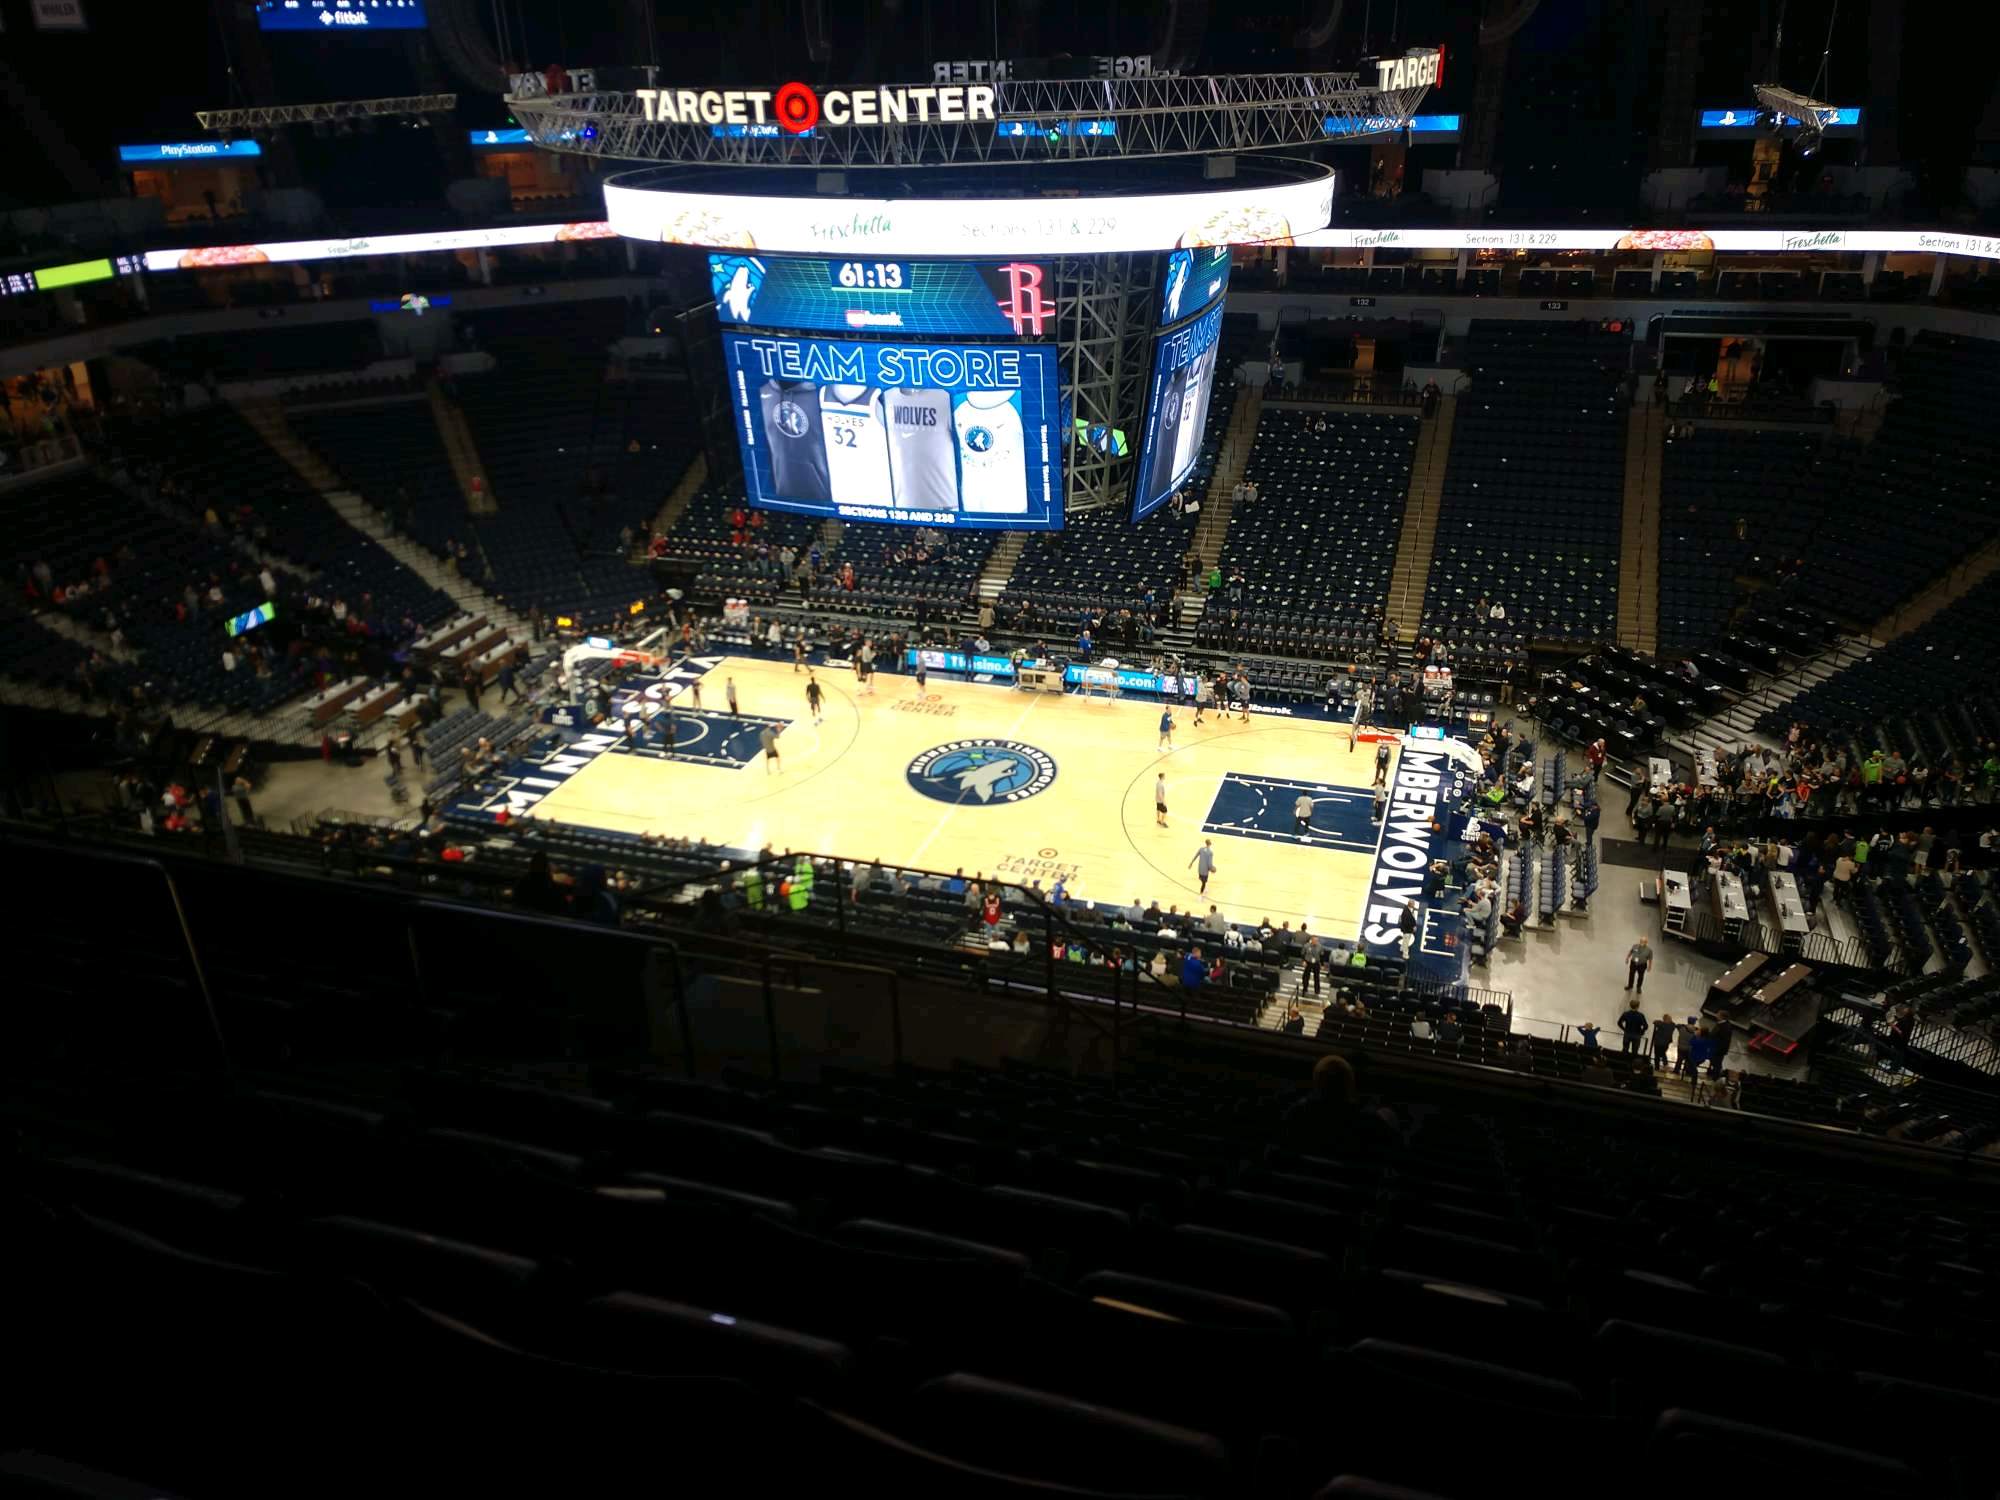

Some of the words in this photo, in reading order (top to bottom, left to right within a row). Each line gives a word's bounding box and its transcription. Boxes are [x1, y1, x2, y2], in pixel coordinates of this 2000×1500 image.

[334, 11, 368, 24] fitbit
[1376, 53, 1440, 92] TARGET
[636, 89, 770, 124] TARGET
[823, 86, 996, 124] CENTER
[161, 144, 217, 157] PlayStation
[1070, 219, 1081, 235] &
[1088, 217, 1117, 236] 229
[1466, 233, 1504, 244] Sections
[1508, 233, 1524, 244] 131
[1538, 234, 1557, 245] 229
[1918, 235, 1960, 249] Sections
[1965, 239, 1981, 251] 131
[839, 262, 903, 288] 61:13
[1171, 317, 1207, 371] TEAM
[751, 339, 866, 382] TEAM
[877, 347, 1021, 387] STORE
[893, 405, 937, 426] WOLVES
[833, 426, 858, 448] 32
[838, 505, 888, 519] SECTIONS
[909, 511, 933, 522] AND
[909, 739, 997, 774] MINNESOTA
[1005, 741, 1054, 802] TIMBERWOLVES
[996, 863, 1078, 881] CENTER
[1004, 855, 1083, 873] TARGET
